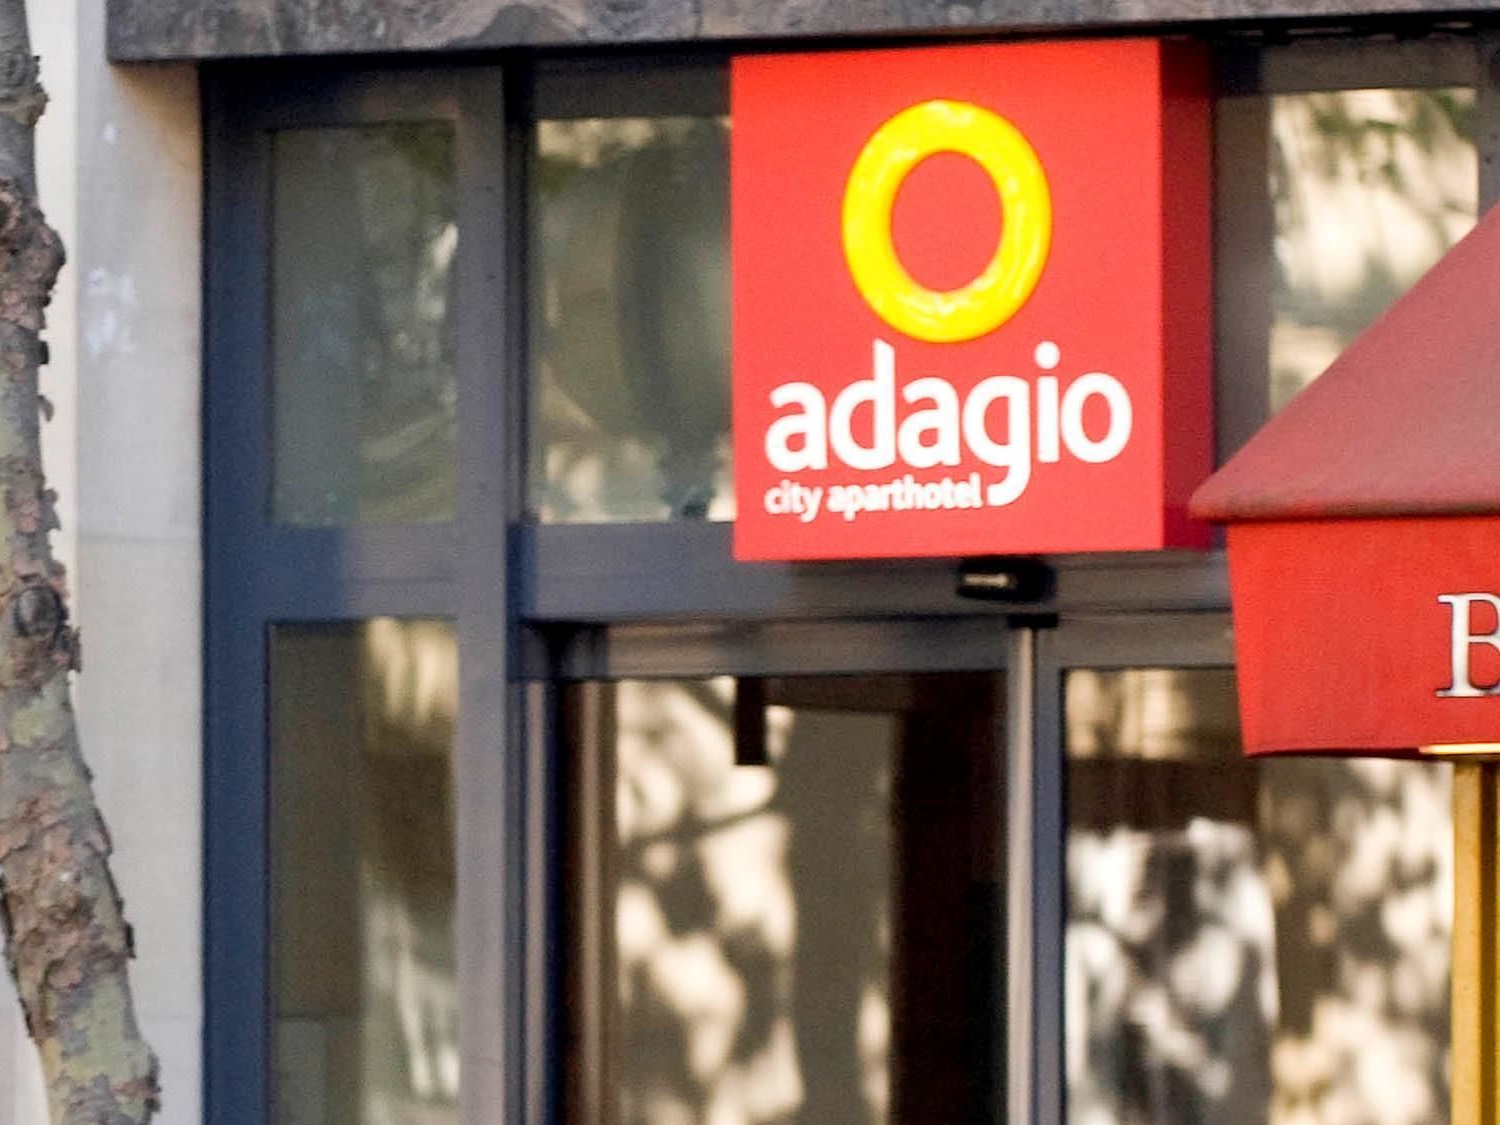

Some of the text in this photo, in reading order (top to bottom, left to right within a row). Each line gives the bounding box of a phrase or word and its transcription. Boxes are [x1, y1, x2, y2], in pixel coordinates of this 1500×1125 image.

[763, 338, 1133, 506] adagio
[763, 472, 983, 524] city aparthotel
